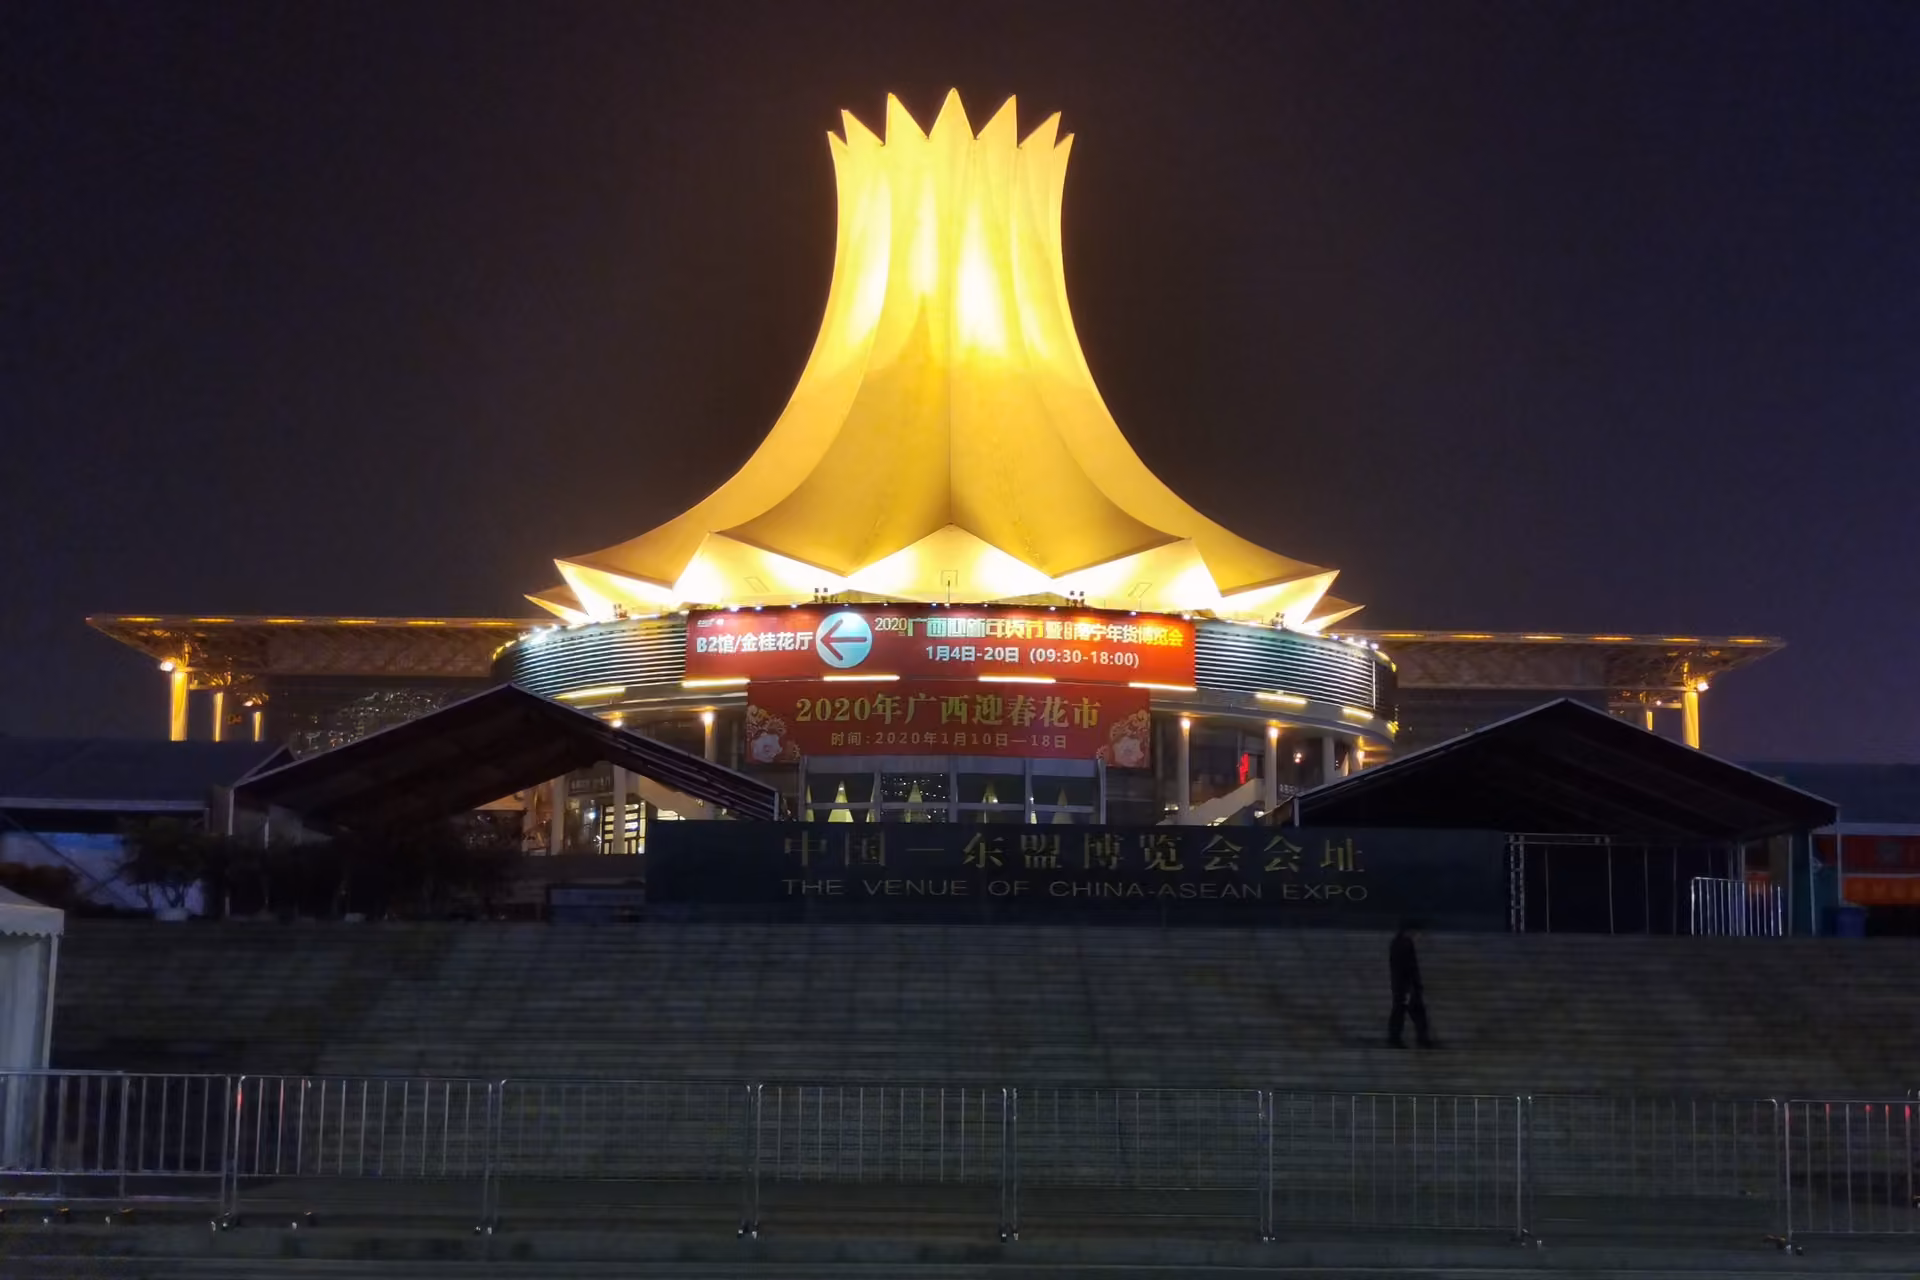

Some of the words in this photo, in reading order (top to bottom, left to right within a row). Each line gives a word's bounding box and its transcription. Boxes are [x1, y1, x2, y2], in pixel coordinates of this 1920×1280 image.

[795, 692, 1102, 730] 2020年广西迎春花市
[781, 878, 845, 896] THE
[862, 879, 969, 897] VENUE
[987, 880, 1030, 897] OF
[1048, 880, 1262, 899] CHINA-ASEAN
[1282, 883, 1368, 901] EXPO
